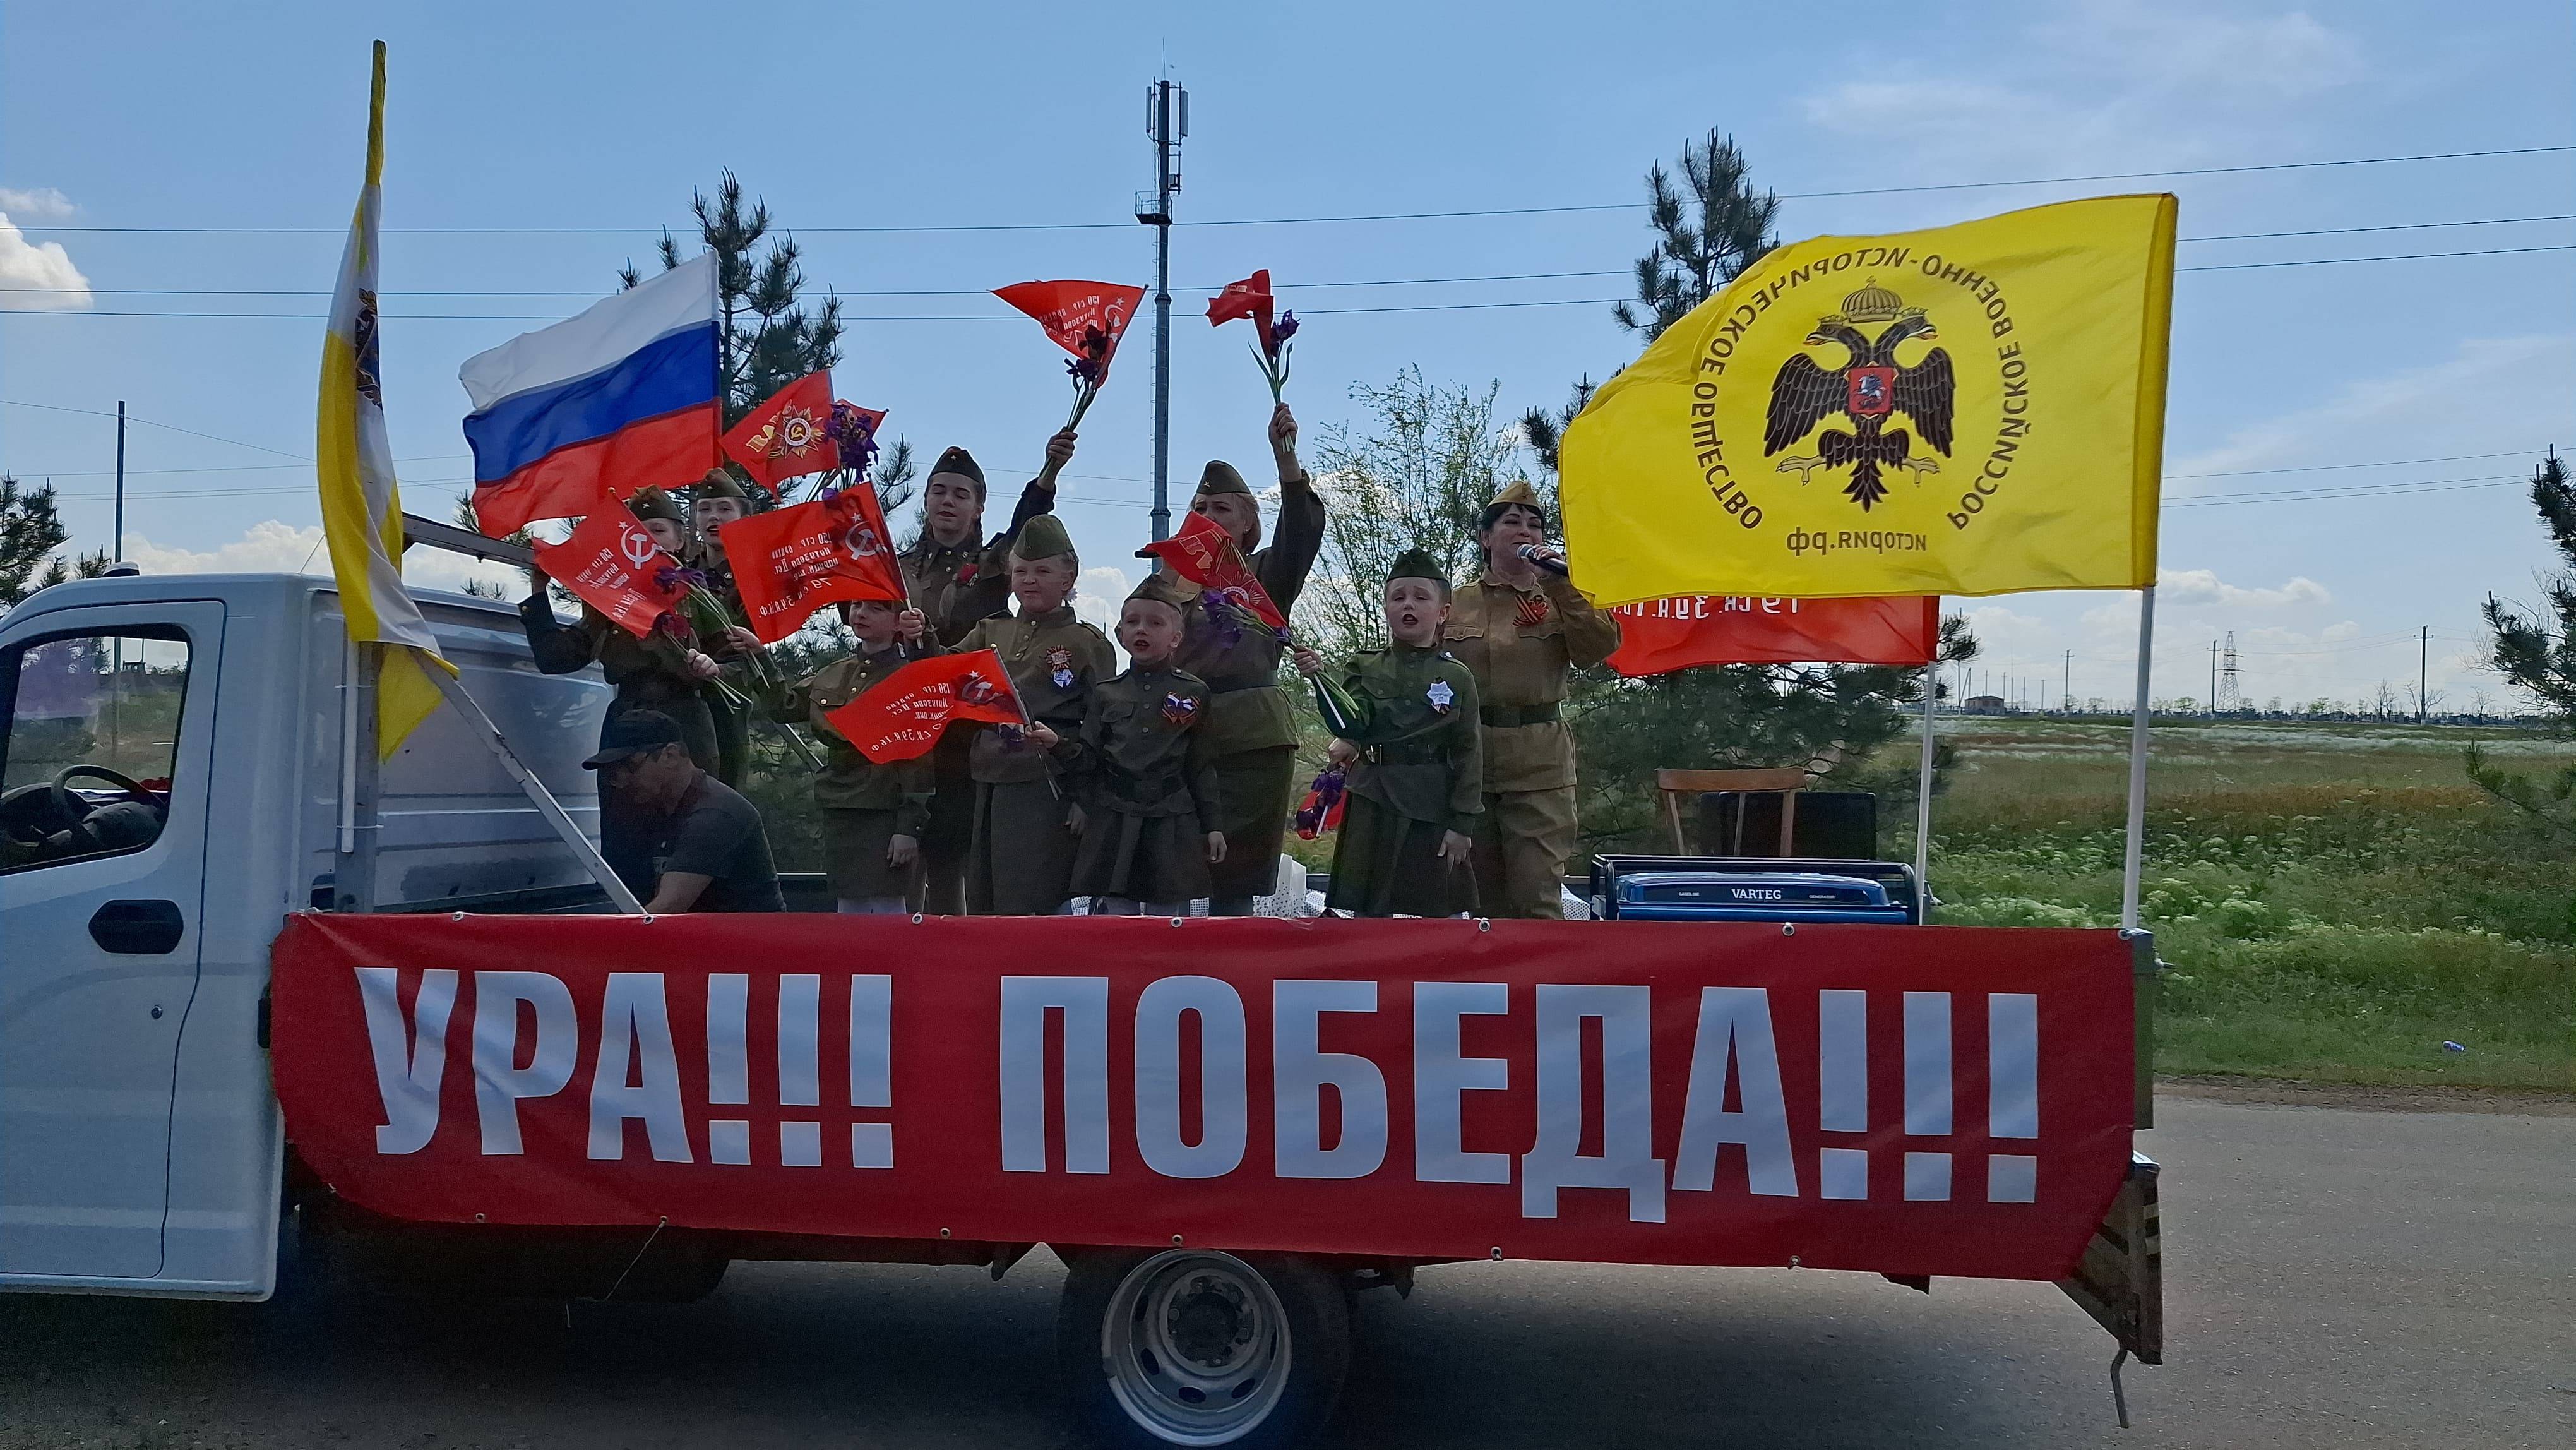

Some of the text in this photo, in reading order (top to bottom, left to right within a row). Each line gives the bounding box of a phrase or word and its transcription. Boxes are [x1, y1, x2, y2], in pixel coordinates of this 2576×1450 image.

[1732, 889, 1782, 899] VARTEG
[354, 966, 2039, 1224] УРА!!! ПОБЕДА!!!
